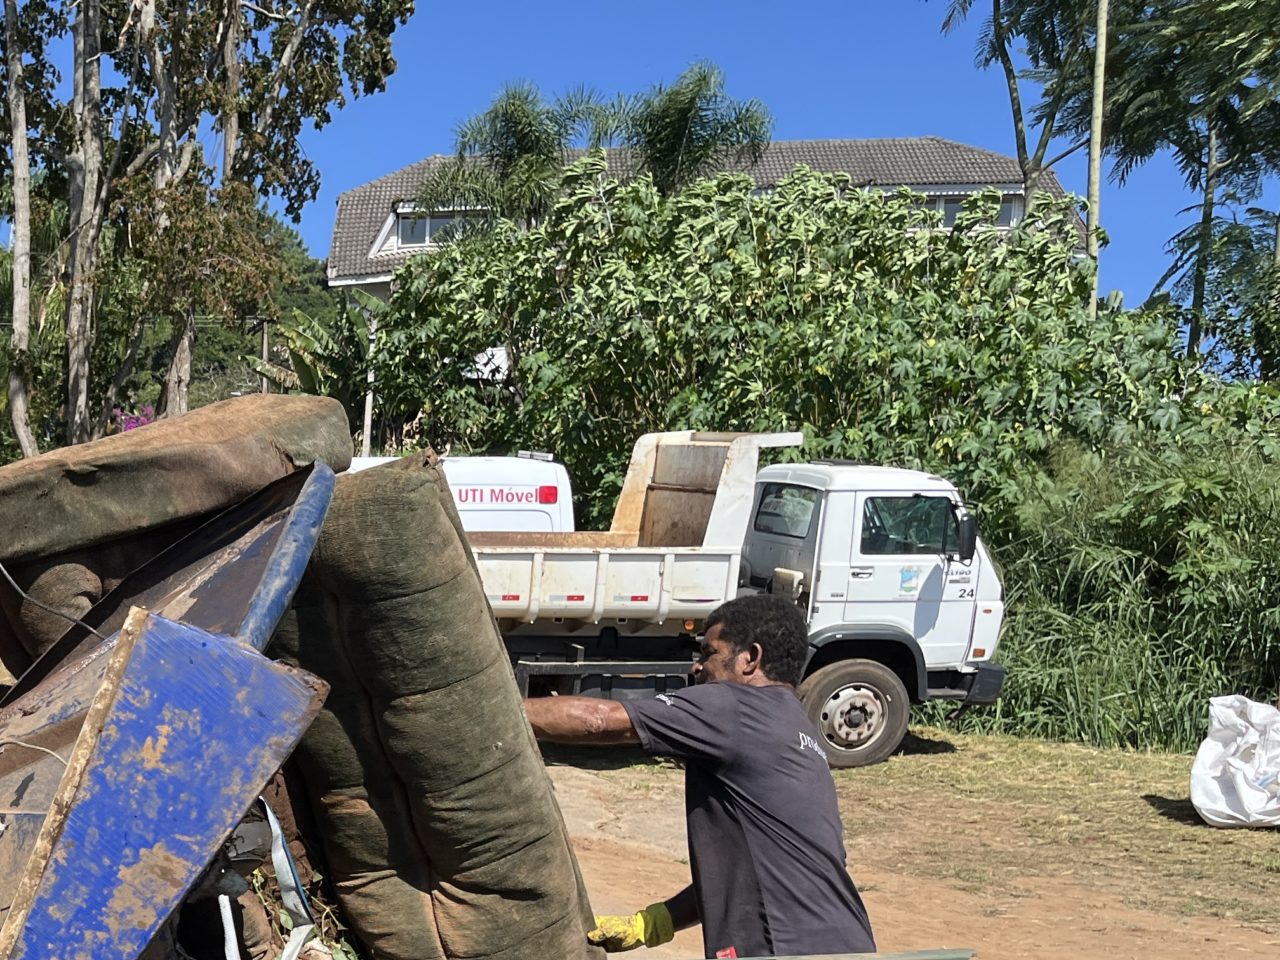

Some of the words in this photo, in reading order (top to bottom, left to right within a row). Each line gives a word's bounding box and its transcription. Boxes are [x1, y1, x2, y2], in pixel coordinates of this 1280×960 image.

[458, 488, 484, 503] UTI
[489, 487, 538, 503] Móvel
[958, 588, 974, 599] 24
